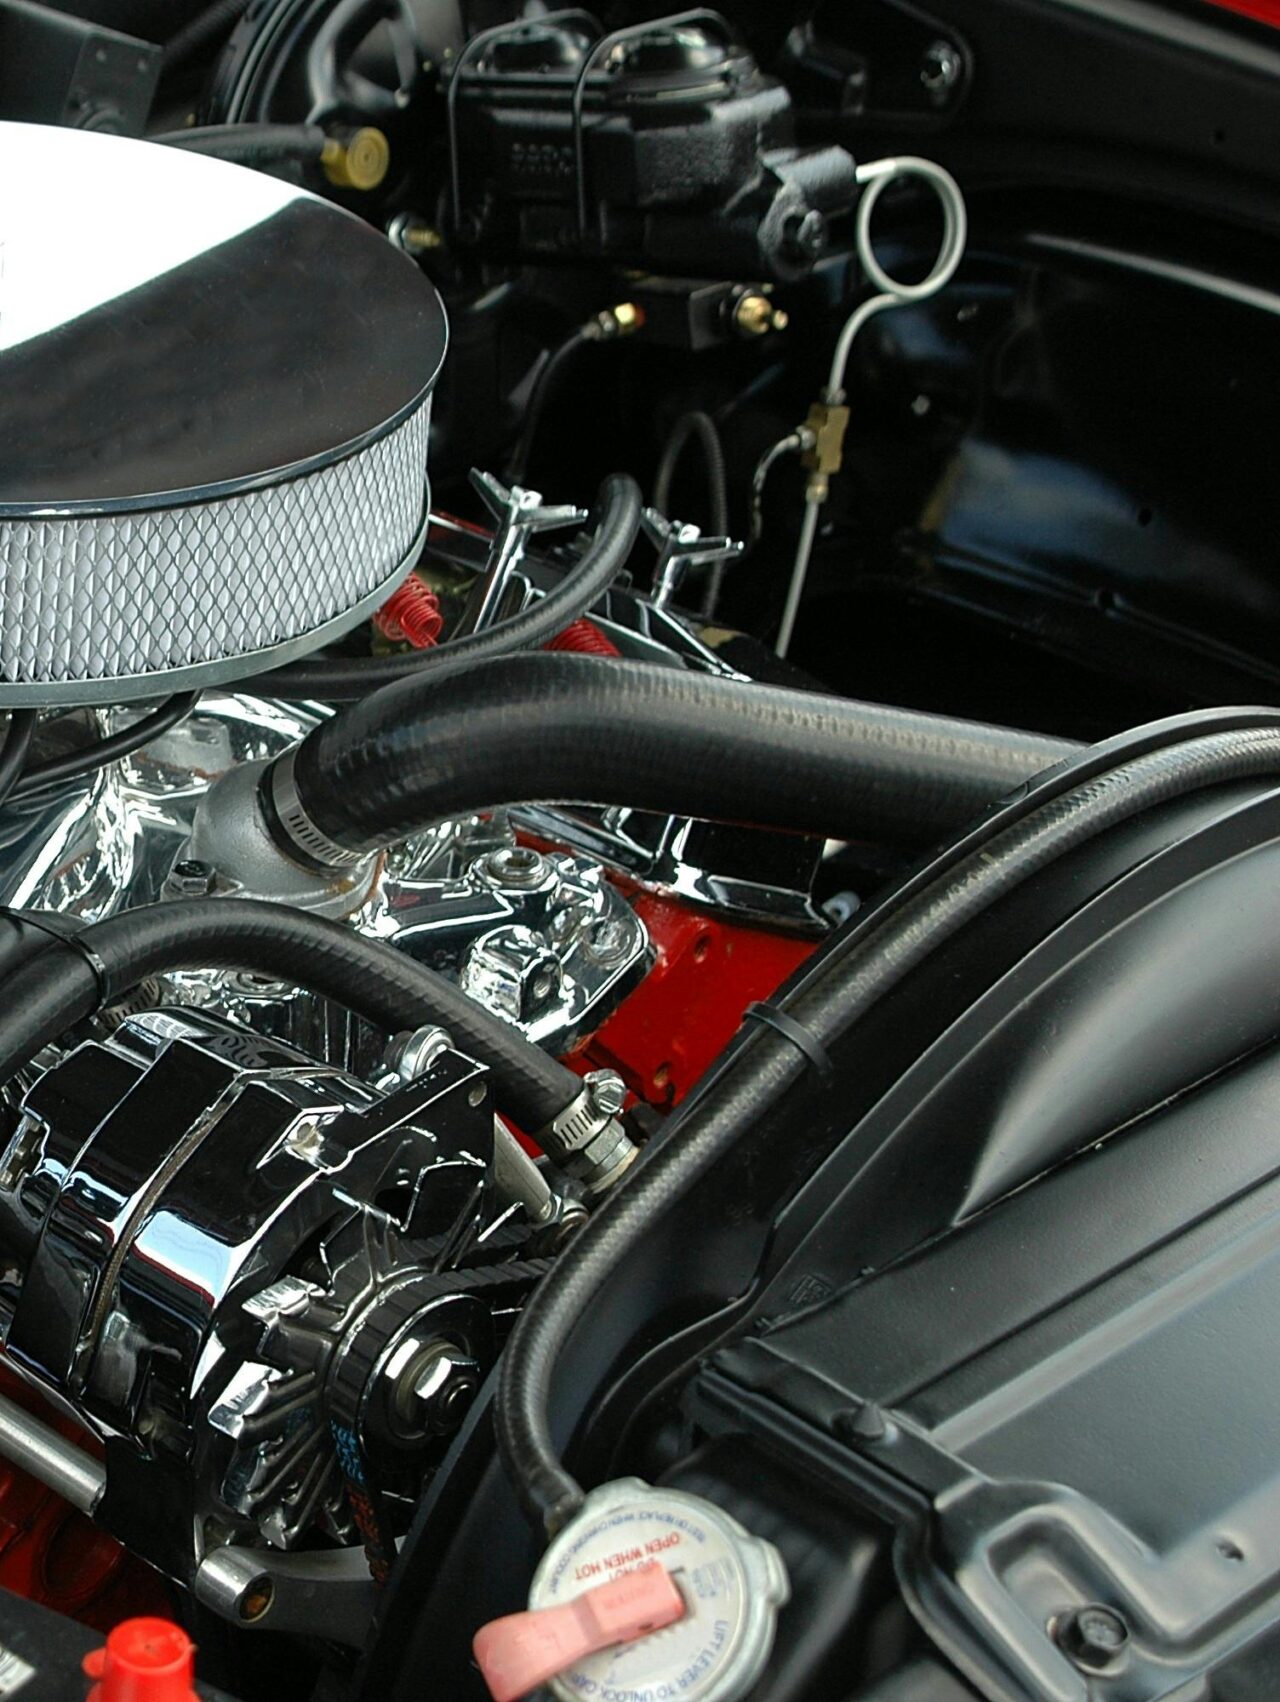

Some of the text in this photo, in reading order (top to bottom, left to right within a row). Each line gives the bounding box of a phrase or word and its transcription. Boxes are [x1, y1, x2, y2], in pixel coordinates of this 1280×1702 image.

[575, 1531, 681, 1580] OPEN WHEN HOT
[710, 1619, 729, 1651] LIFT
[678, 1648, 715, 1689] LEVER
[599, 1685, 654, 1702] UNLOCK
[656, 1684, 677, 1700] TO
